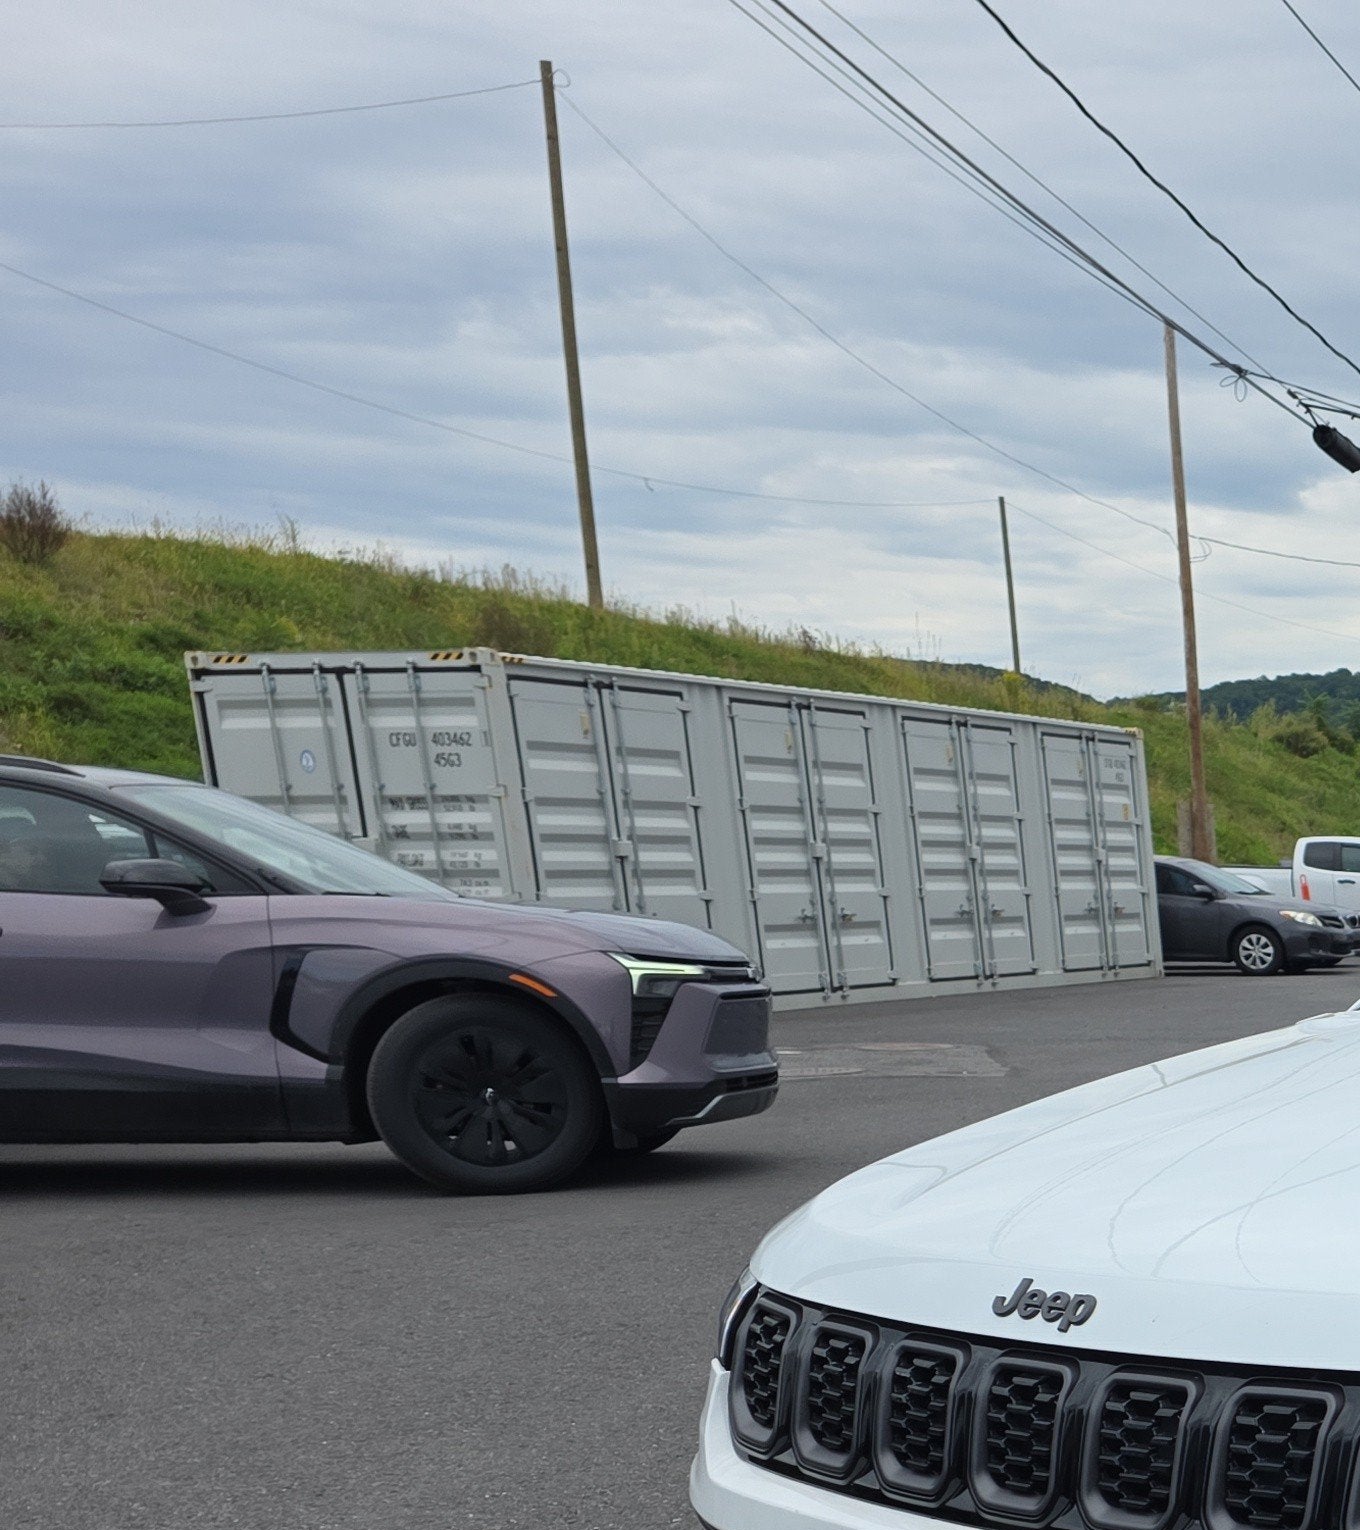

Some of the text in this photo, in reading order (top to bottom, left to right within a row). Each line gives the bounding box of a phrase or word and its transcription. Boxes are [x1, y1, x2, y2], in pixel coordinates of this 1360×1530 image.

[431, 731, 472, 747] 403462
[434, 752, 461, 768] 45G3
[992, 1278, 1098, 1333] Jeep
